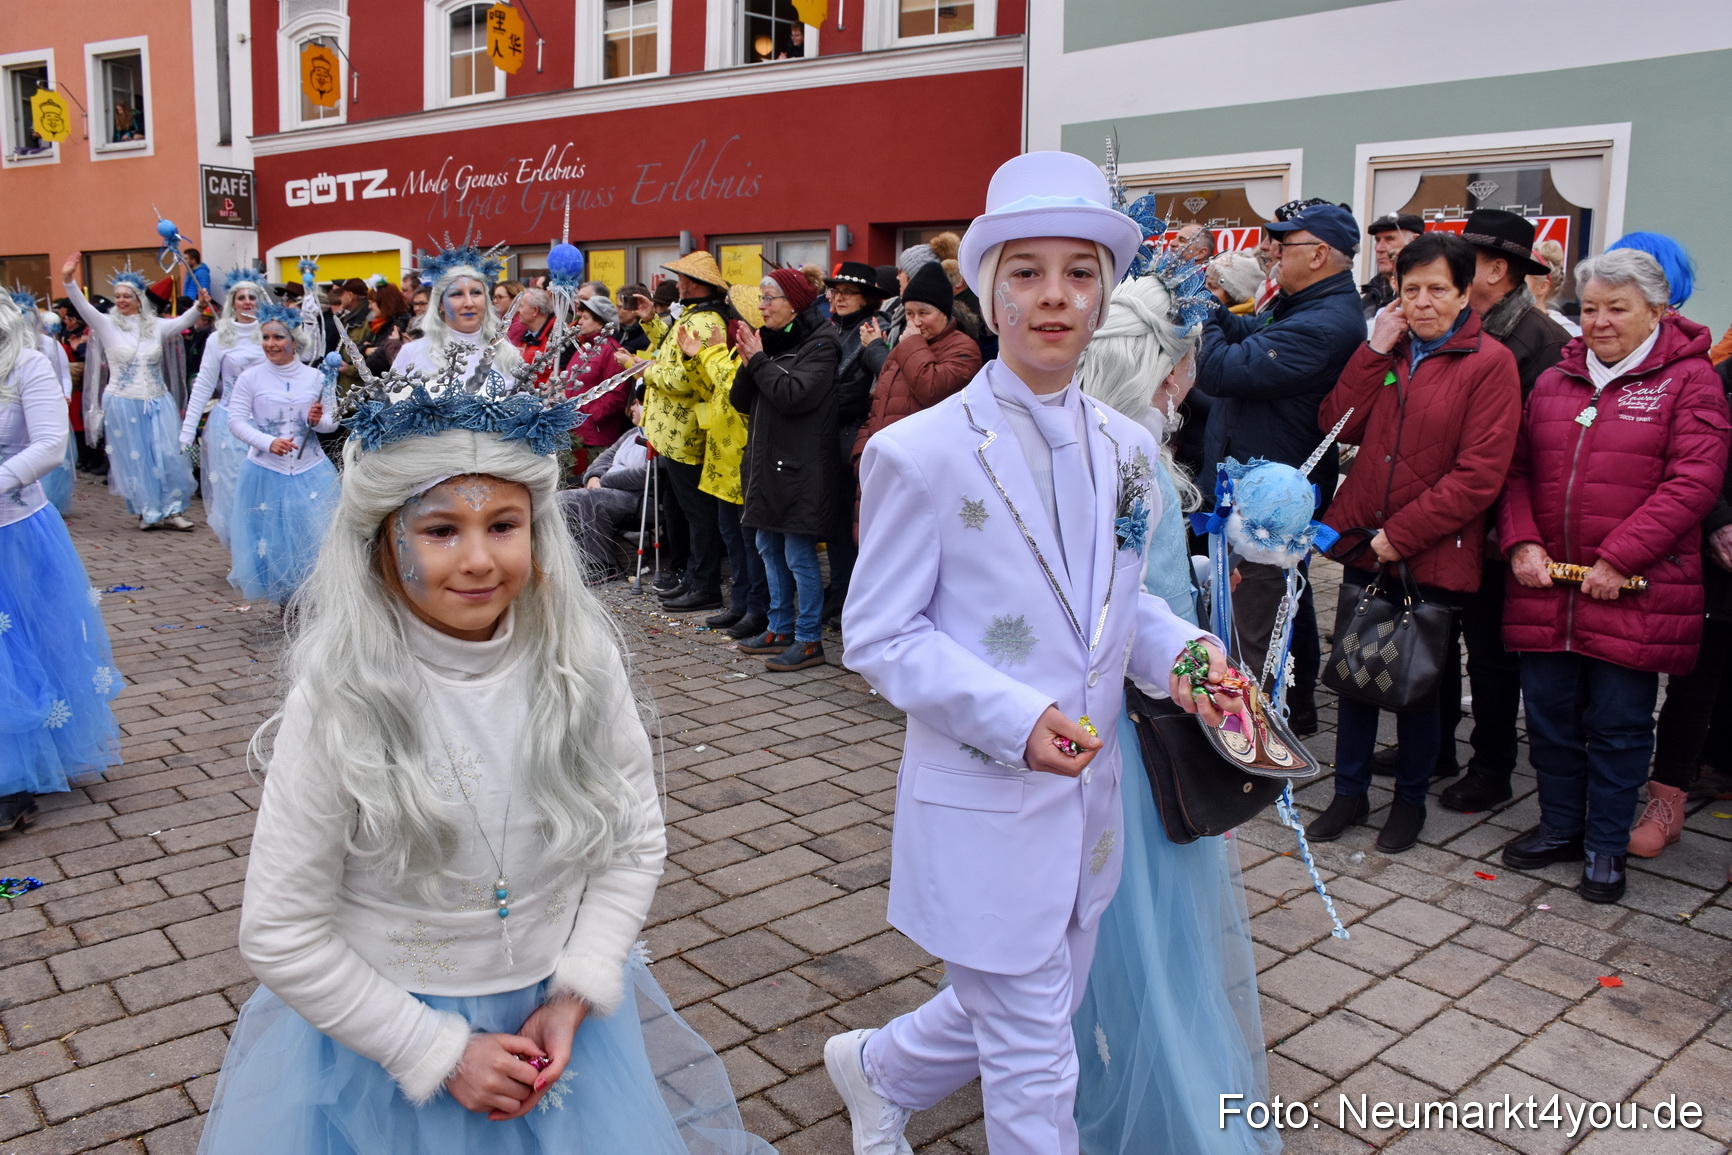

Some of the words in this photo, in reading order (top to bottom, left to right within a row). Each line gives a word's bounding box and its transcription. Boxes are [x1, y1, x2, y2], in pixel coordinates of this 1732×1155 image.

[208, 175, 249, 198] CAFÉ
[401, 156, 453, 198] Mode
[455, 164, 509, 203] Genuss
[516, 141, 586, 184] Erlebnis
[521, 168, 616, 234] Genuss
[631, 134, 762, 206] Erlebnis
[1617, 377, 1673, 402] Sail
